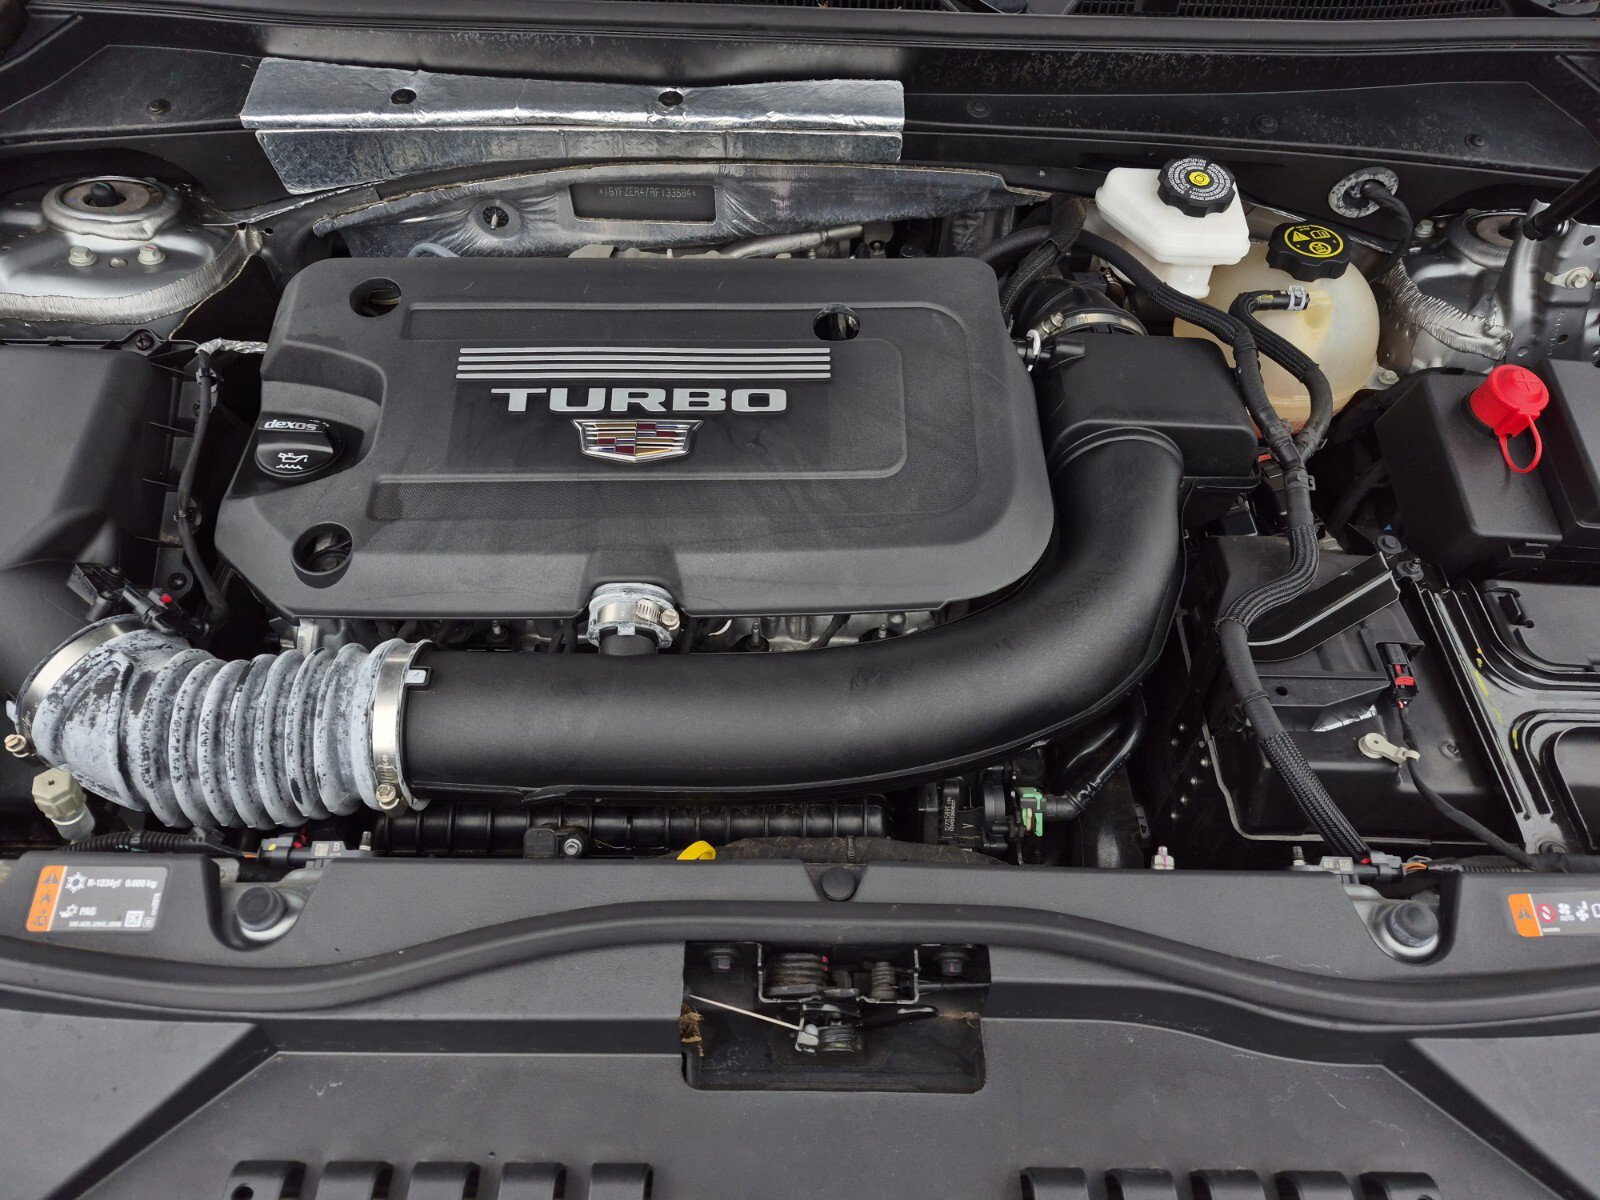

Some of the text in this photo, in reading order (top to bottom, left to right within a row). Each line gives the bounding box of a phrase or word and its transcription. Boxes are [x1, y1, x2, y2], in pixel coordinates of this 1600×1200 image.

[490, 387, 788, 413] TURBO
[263, 419, 319, 431] dexos
[87, 878, 122, 889] R-1234yf
[146, 879, 158, 889] kg
[79, 906, 97, 916] PAG
